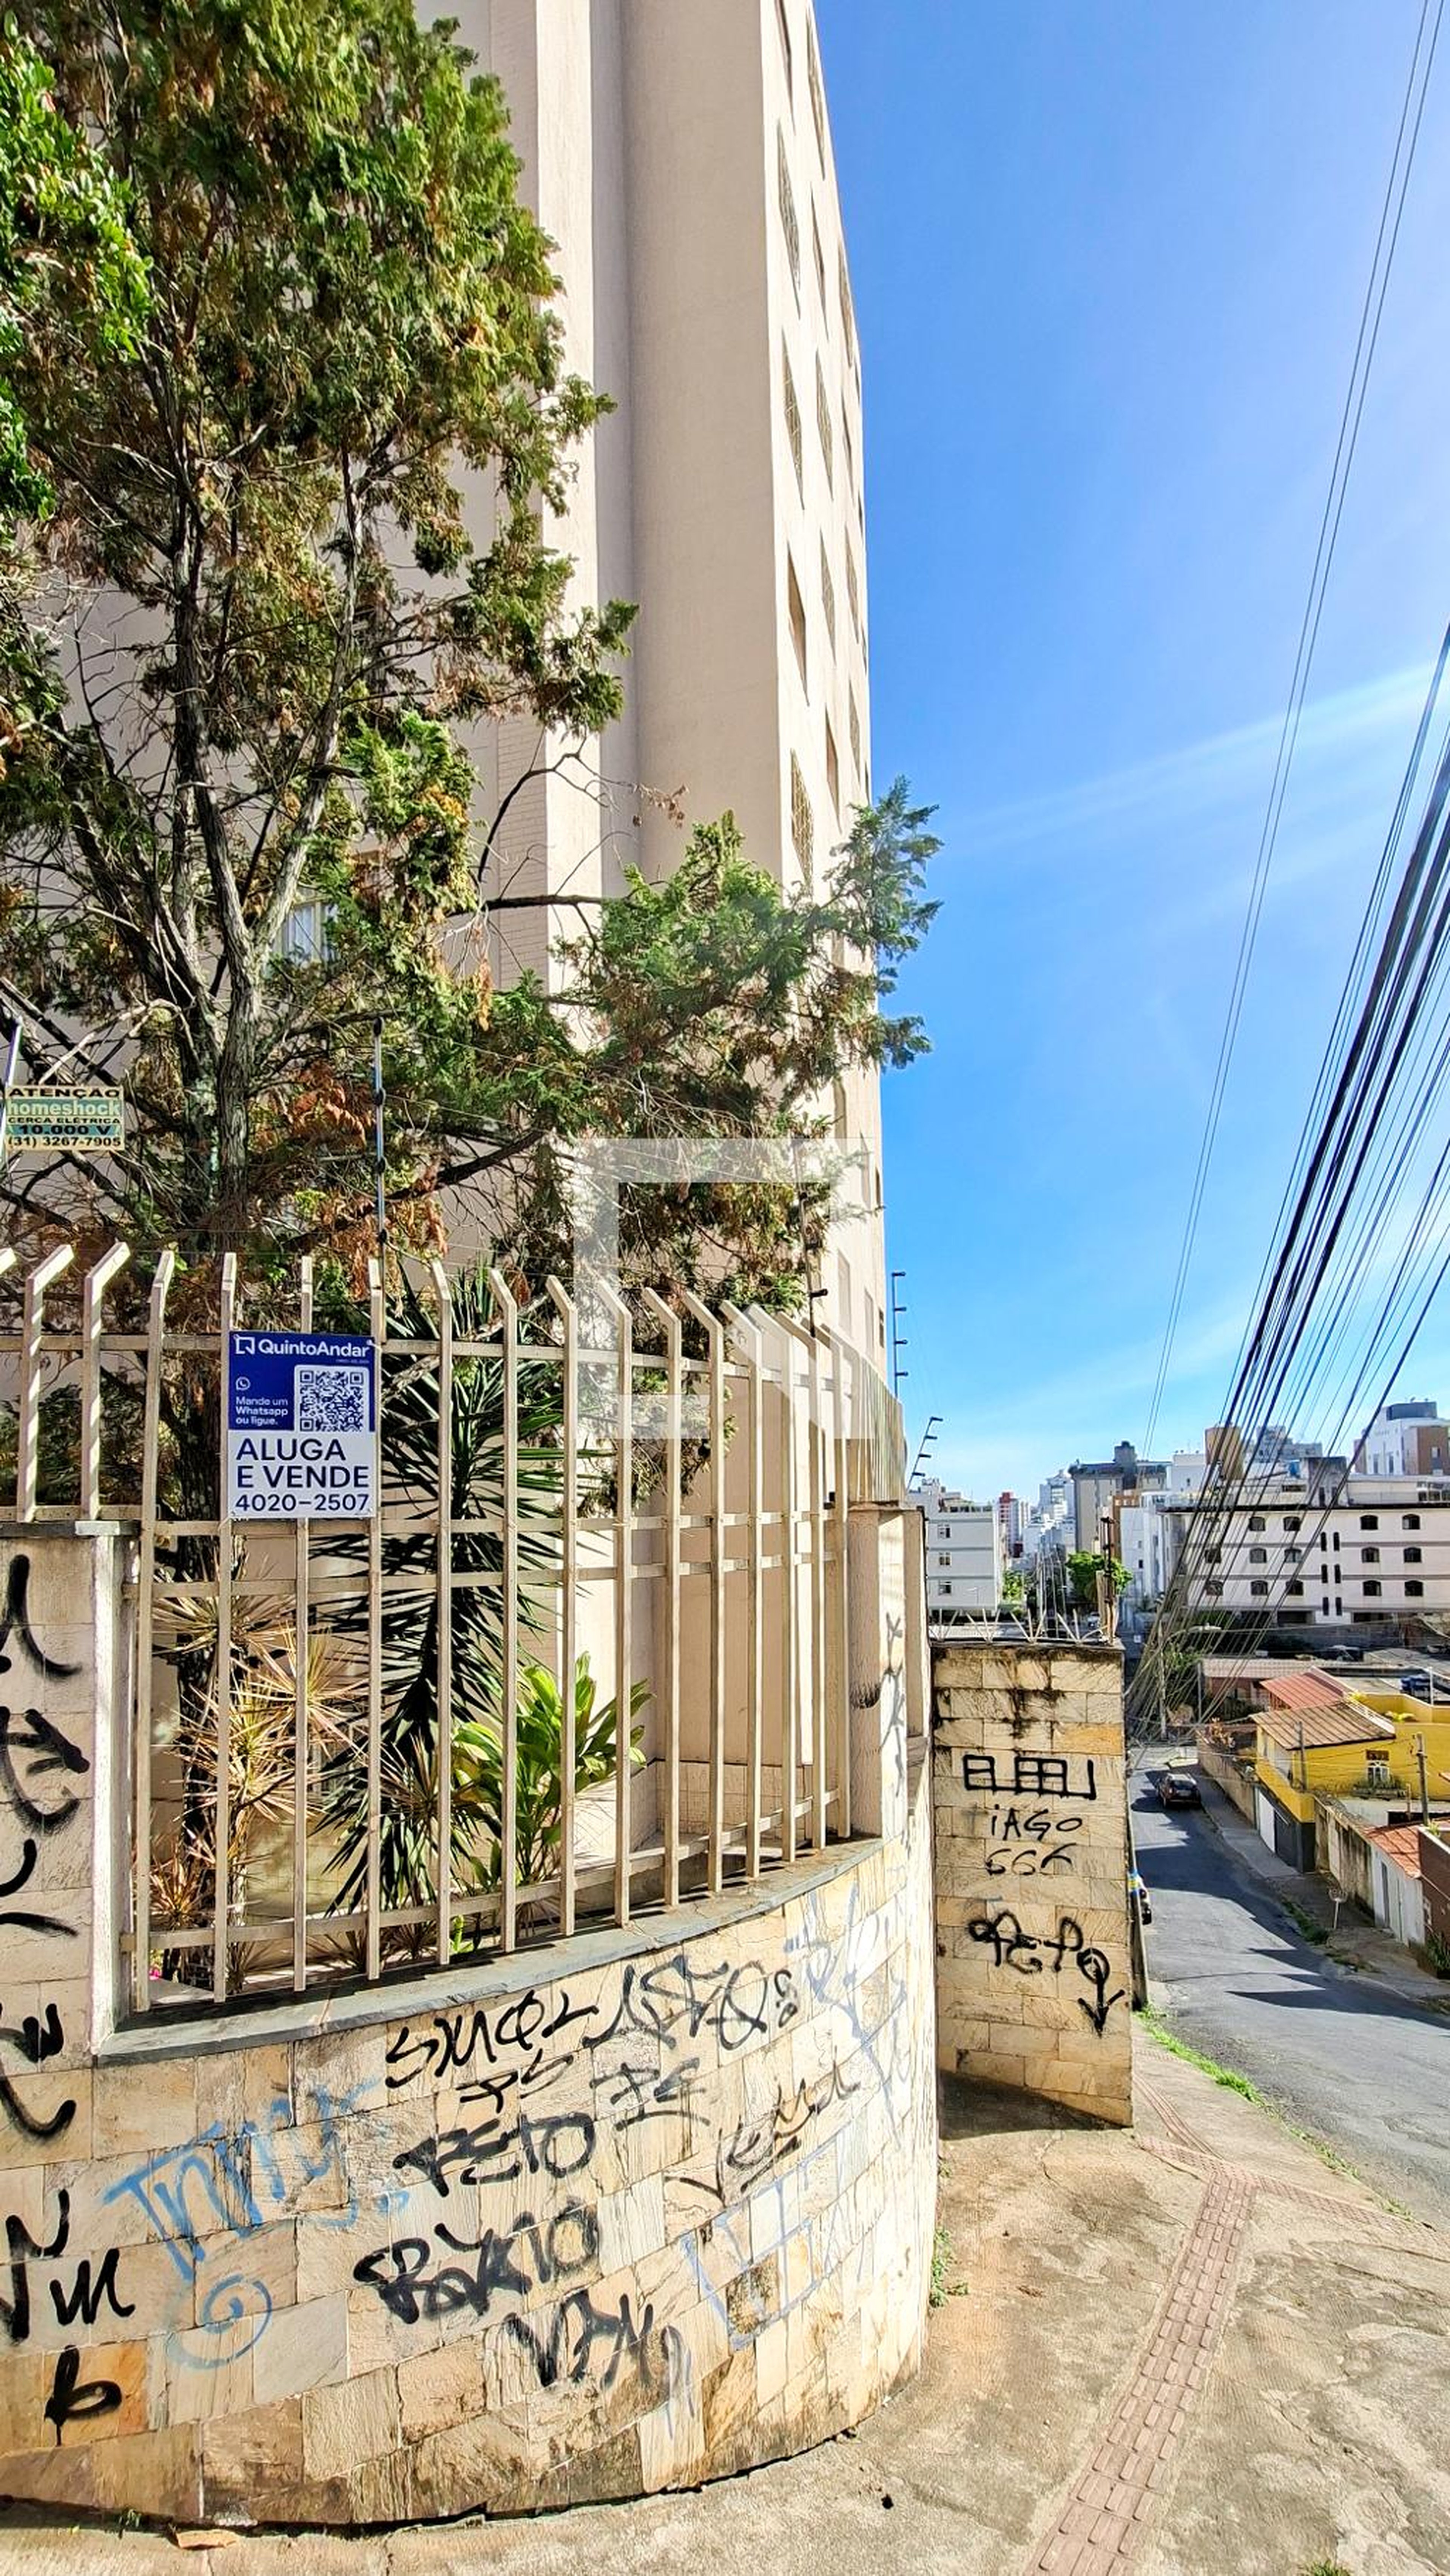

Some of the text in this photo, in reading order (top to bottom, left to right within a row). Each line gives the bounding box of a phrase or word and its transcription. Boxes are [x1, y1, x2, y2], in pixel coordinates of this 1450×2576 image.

[8, 1099, 120, 1115] homeshock
[20, 1125, 111, 1134] 10.000 V
[8, 1136, 121, 1147] (31) 3267-7905
[258, 1339, 369, 1357] QuintoAndar
[236, 1397, 271, 1405] Mande
[236, 1438, 346, 1461] ALUGA
[237, 1466, 369, 1488] E VENDE
[236, 1494, 369, 1511] 4020-2507
